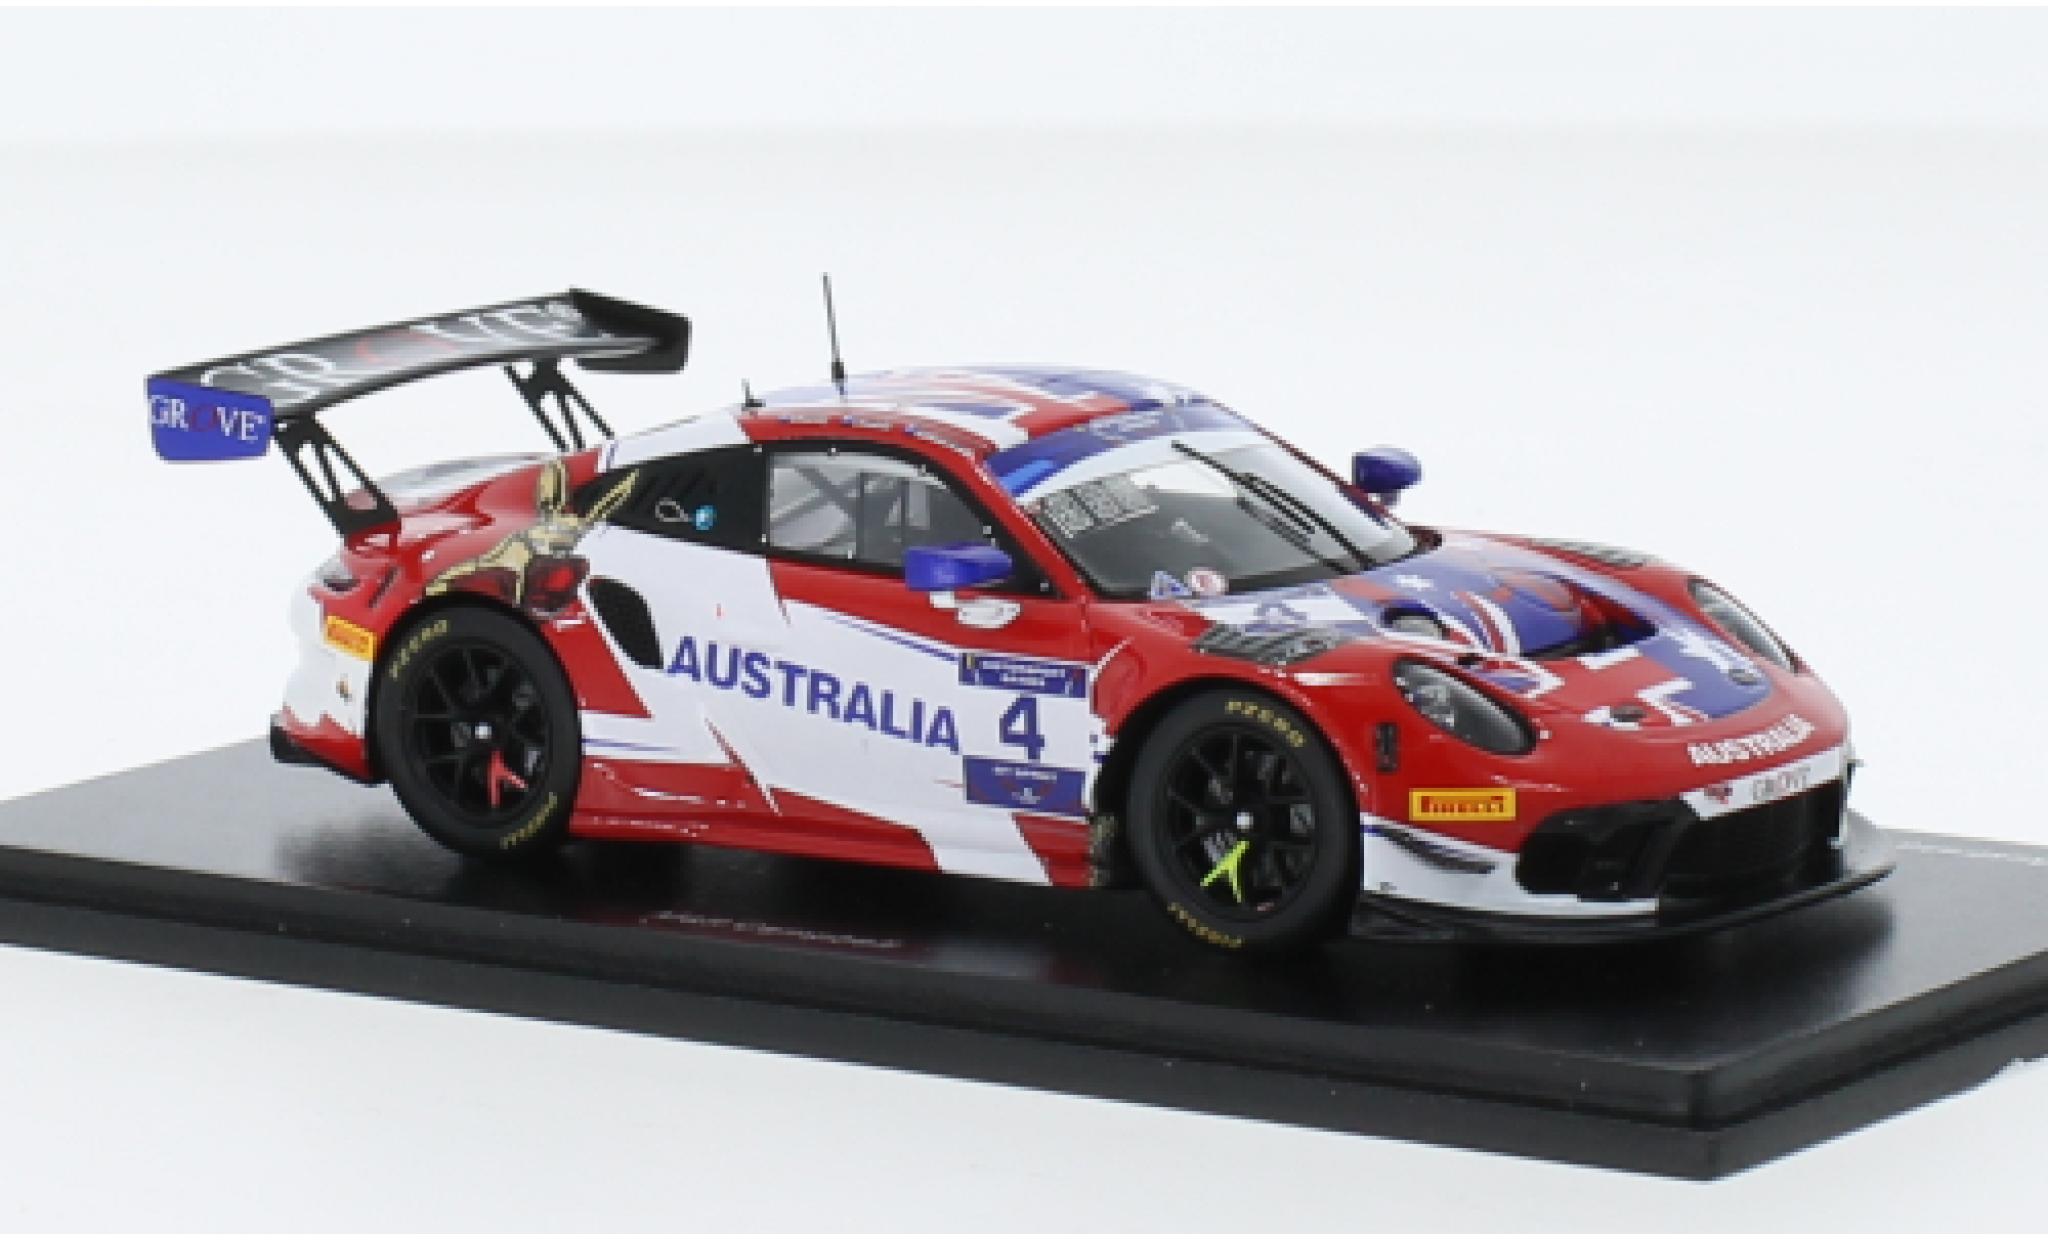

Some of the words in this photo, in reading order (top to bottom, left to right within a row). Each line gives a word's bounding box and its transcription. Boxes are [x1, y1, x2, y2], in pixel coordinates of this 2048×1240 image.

[667, 635, 960, 755] AUSTRALIA
[1000, 694, 1045, 761] 4
[1687, 714, 1816, 767] AUSTRALIA
